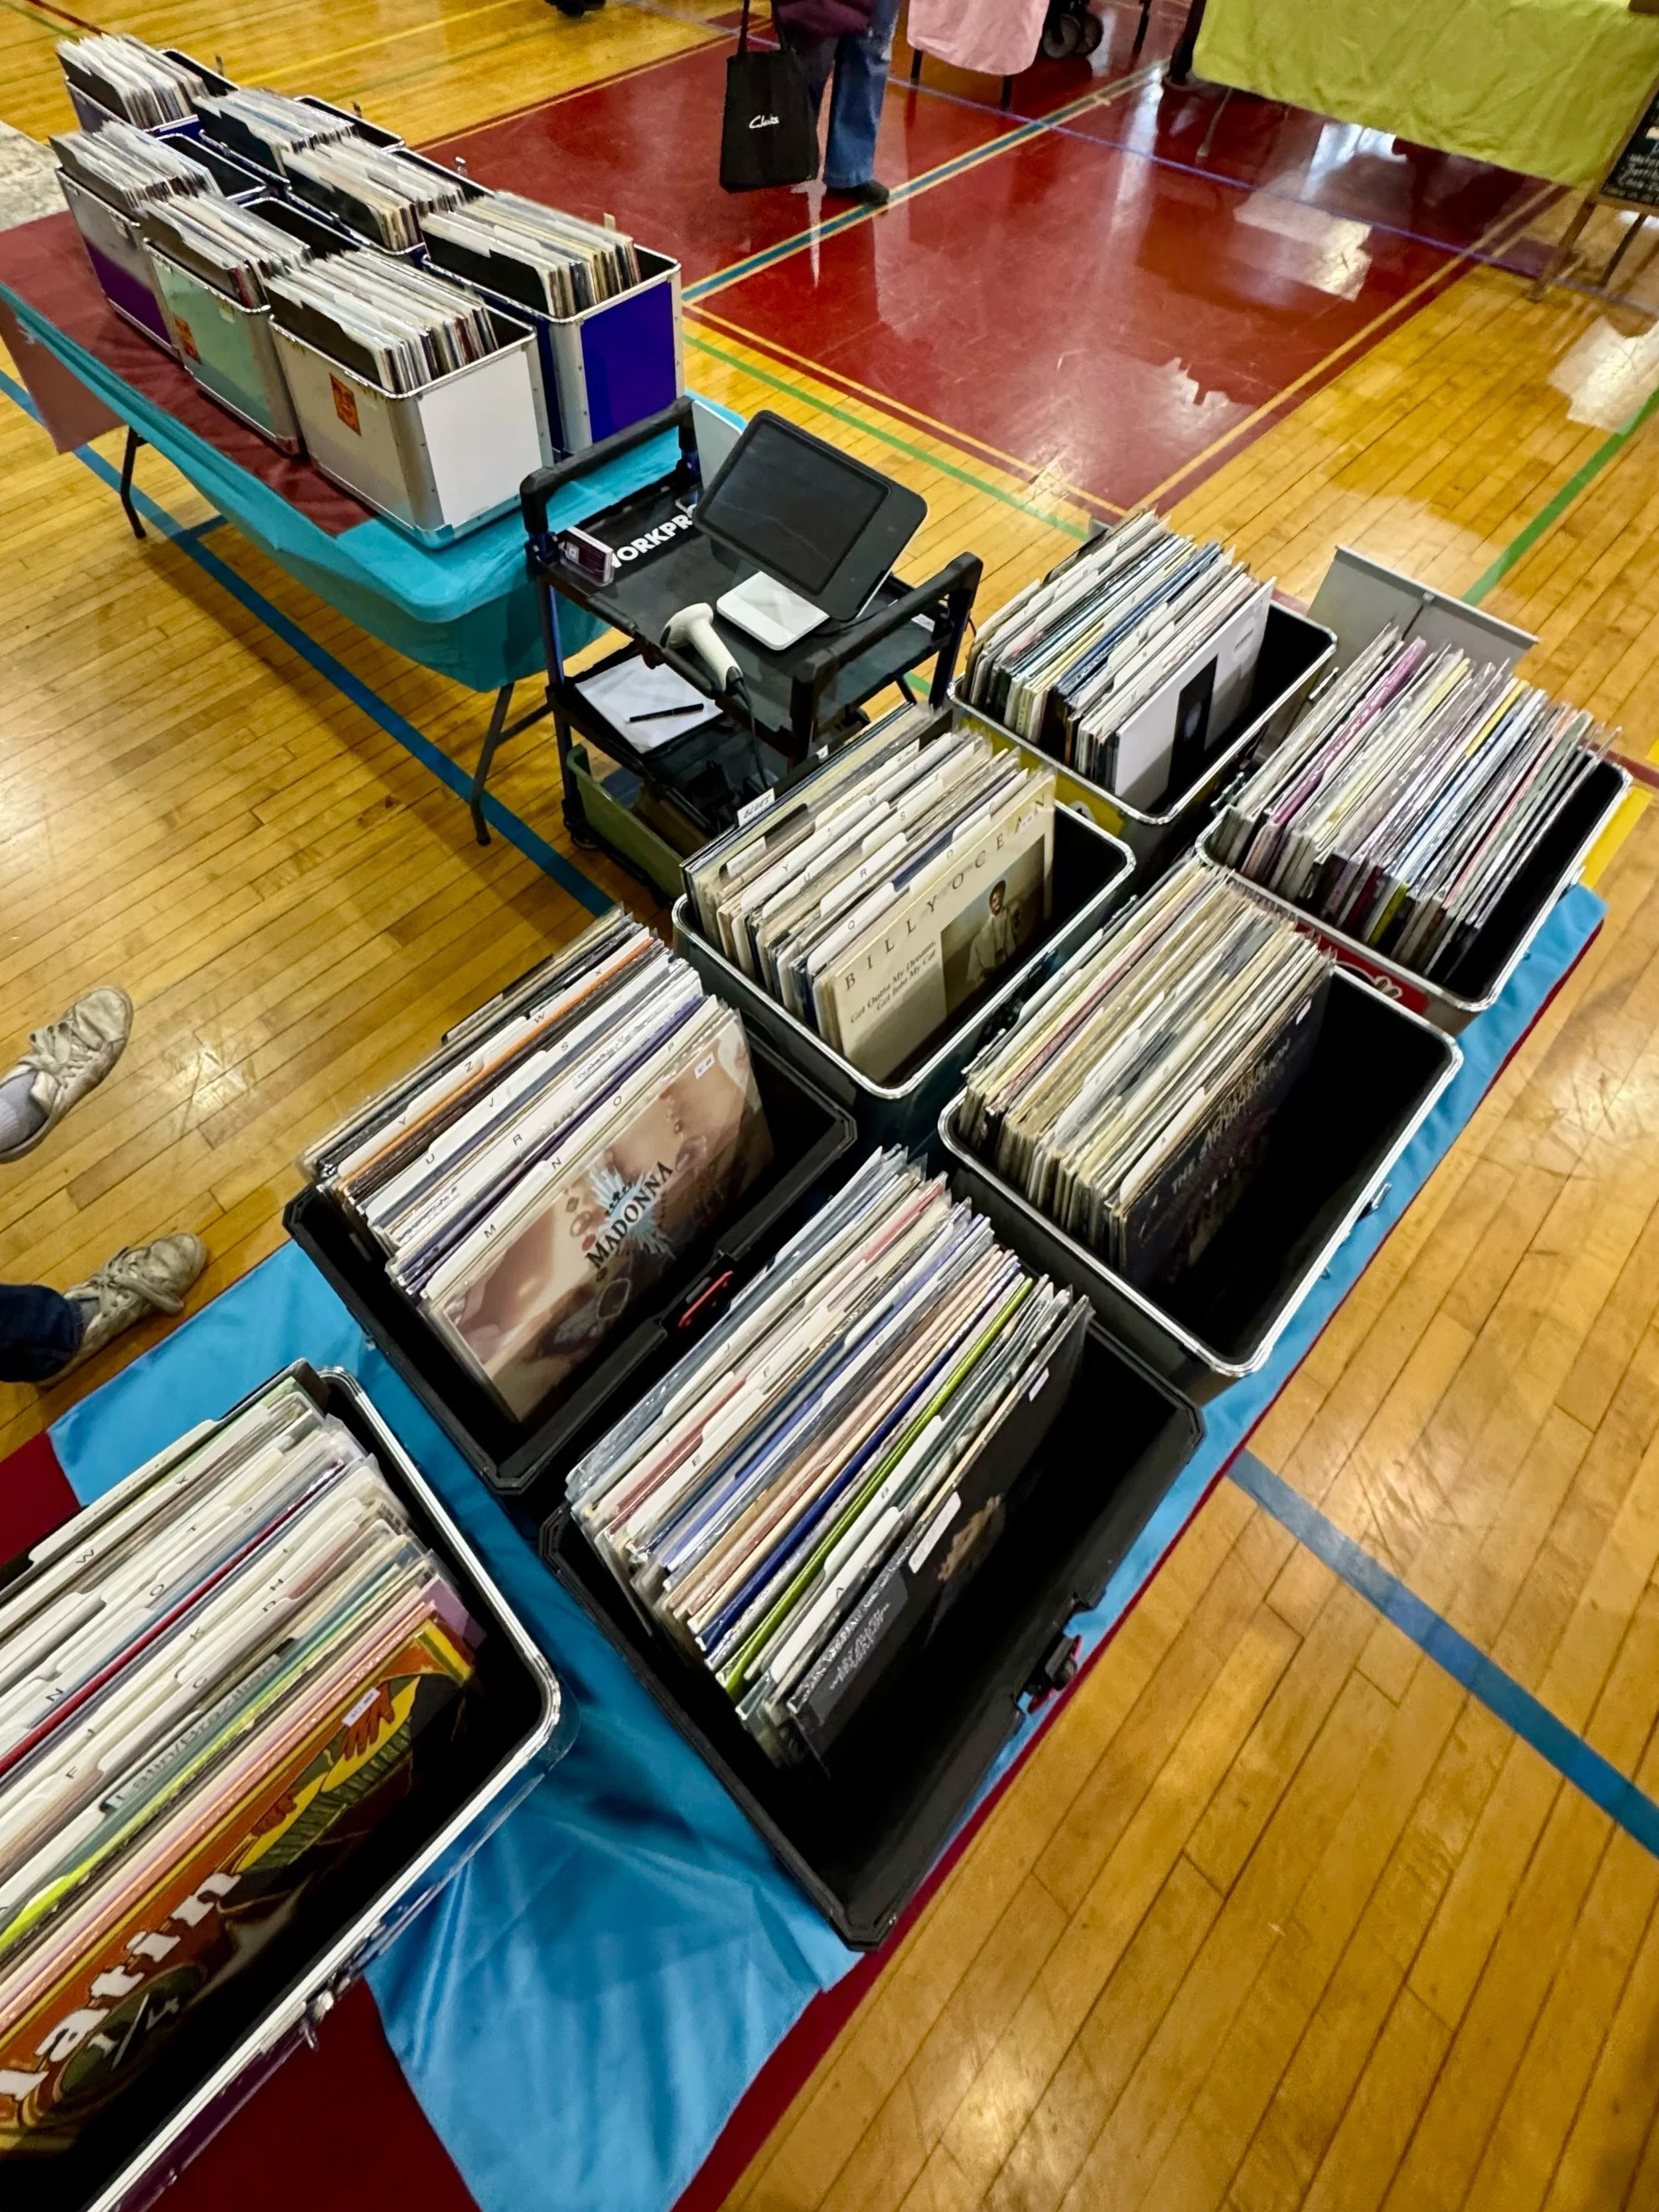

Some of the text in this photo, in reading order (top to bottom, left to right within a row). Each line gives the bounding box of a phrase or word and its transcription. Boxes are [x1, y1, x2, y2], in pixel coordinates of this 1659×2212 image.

[859, 868, 868, 879] R
[843, 793, 1046, 992] BILLY OCEAN
[876, 948, 937, 1011] Get Into My Car
[850, 1006, 866, 1024] Get
[867, 982, 891, 1009] Outta
[892, 968, 906, 984] My
[534, 1011, 546, 1024] W
[560, 1041, 569, 1053] S
[463, 1061, 473, 1072] Z
[613, 1095, 622, 1108] O
[397, 1116, 407, 1126] Y
[512, 1133, 524, 1146] R
[425, 1153, 436, 1165] U
[551, 1157, 563, 1170] N
[585, 1161, 674, 1270] MADONNA
[483, 1224, 497, 1239] M
[176, 1475, 188, 1486] X
[75, 1548, 95, 1565] W
[149, 1584, 165, 1597] O
[44, 1687, 65, 1703] N
[65, 1765, 78, 1780] F
